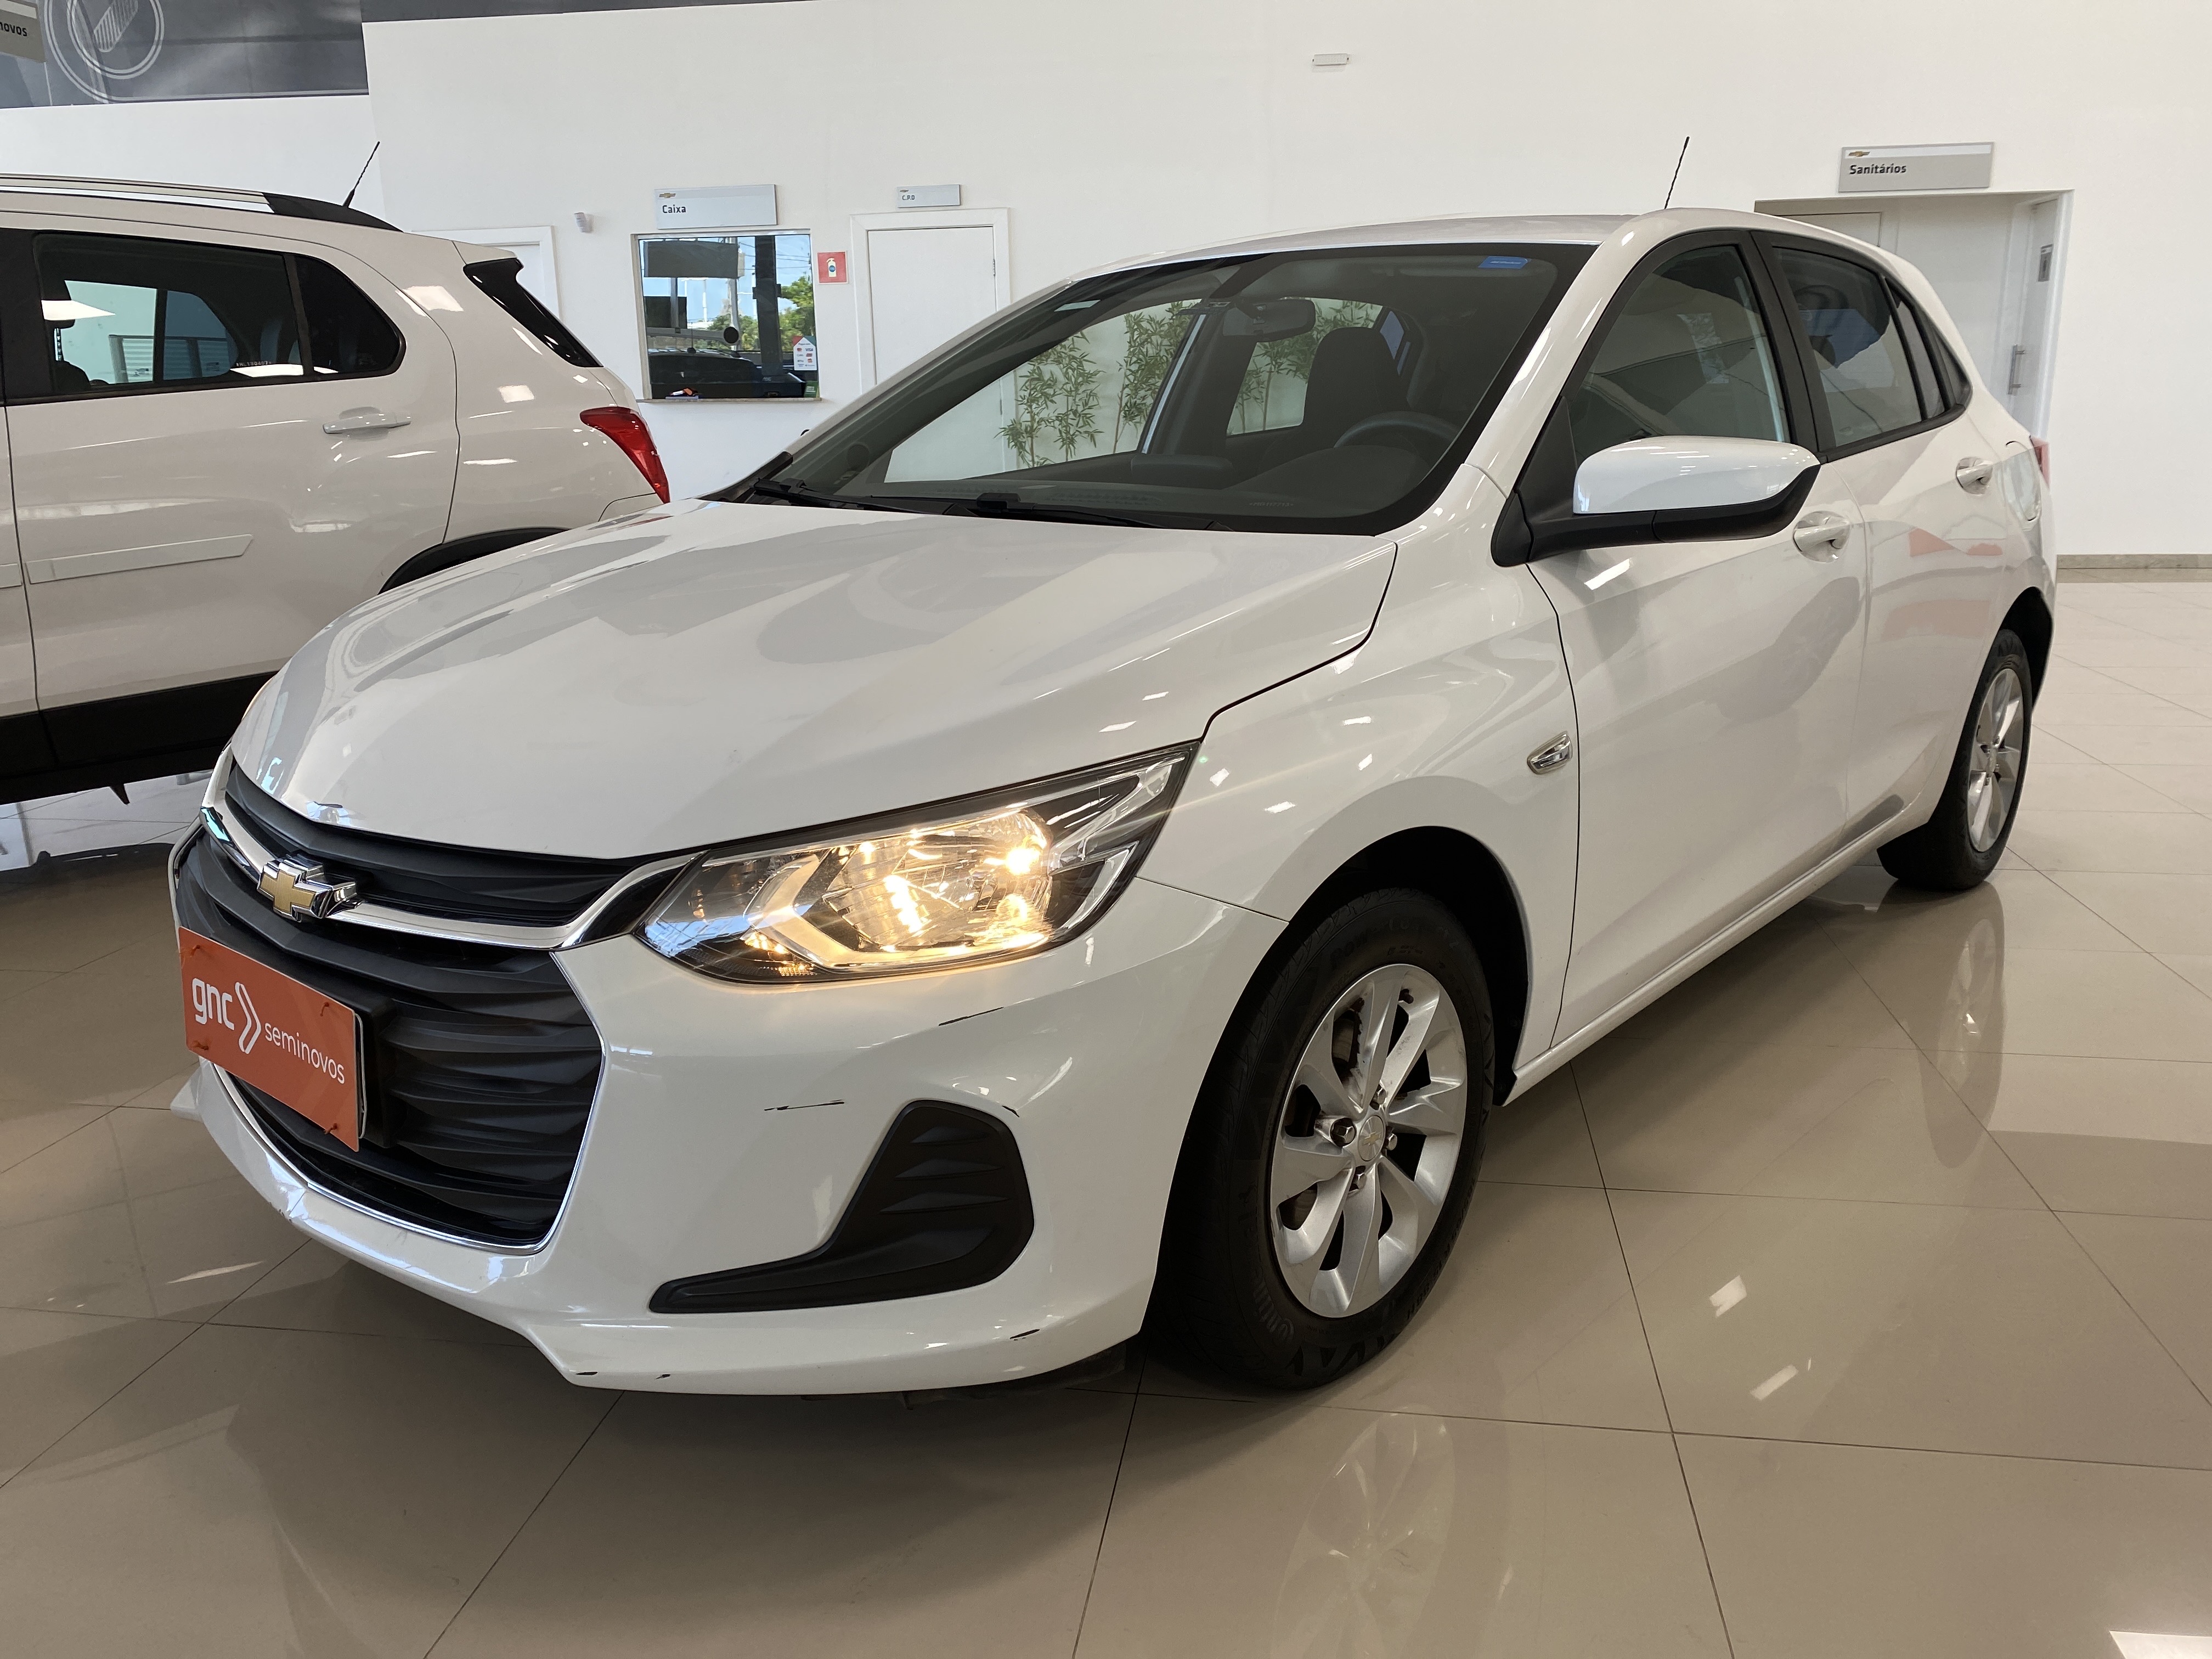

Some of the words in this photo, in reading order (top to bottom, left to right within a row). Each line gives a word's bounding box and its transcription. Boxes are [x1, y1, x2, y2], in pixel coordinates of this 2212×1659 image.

[1849, 163, 1906, 174] Sanitários
[662, 204, 686, 213] Caixa
[192, 978, 235, 1031] gnc
[264, 1022, 345, 1085] seminovos
